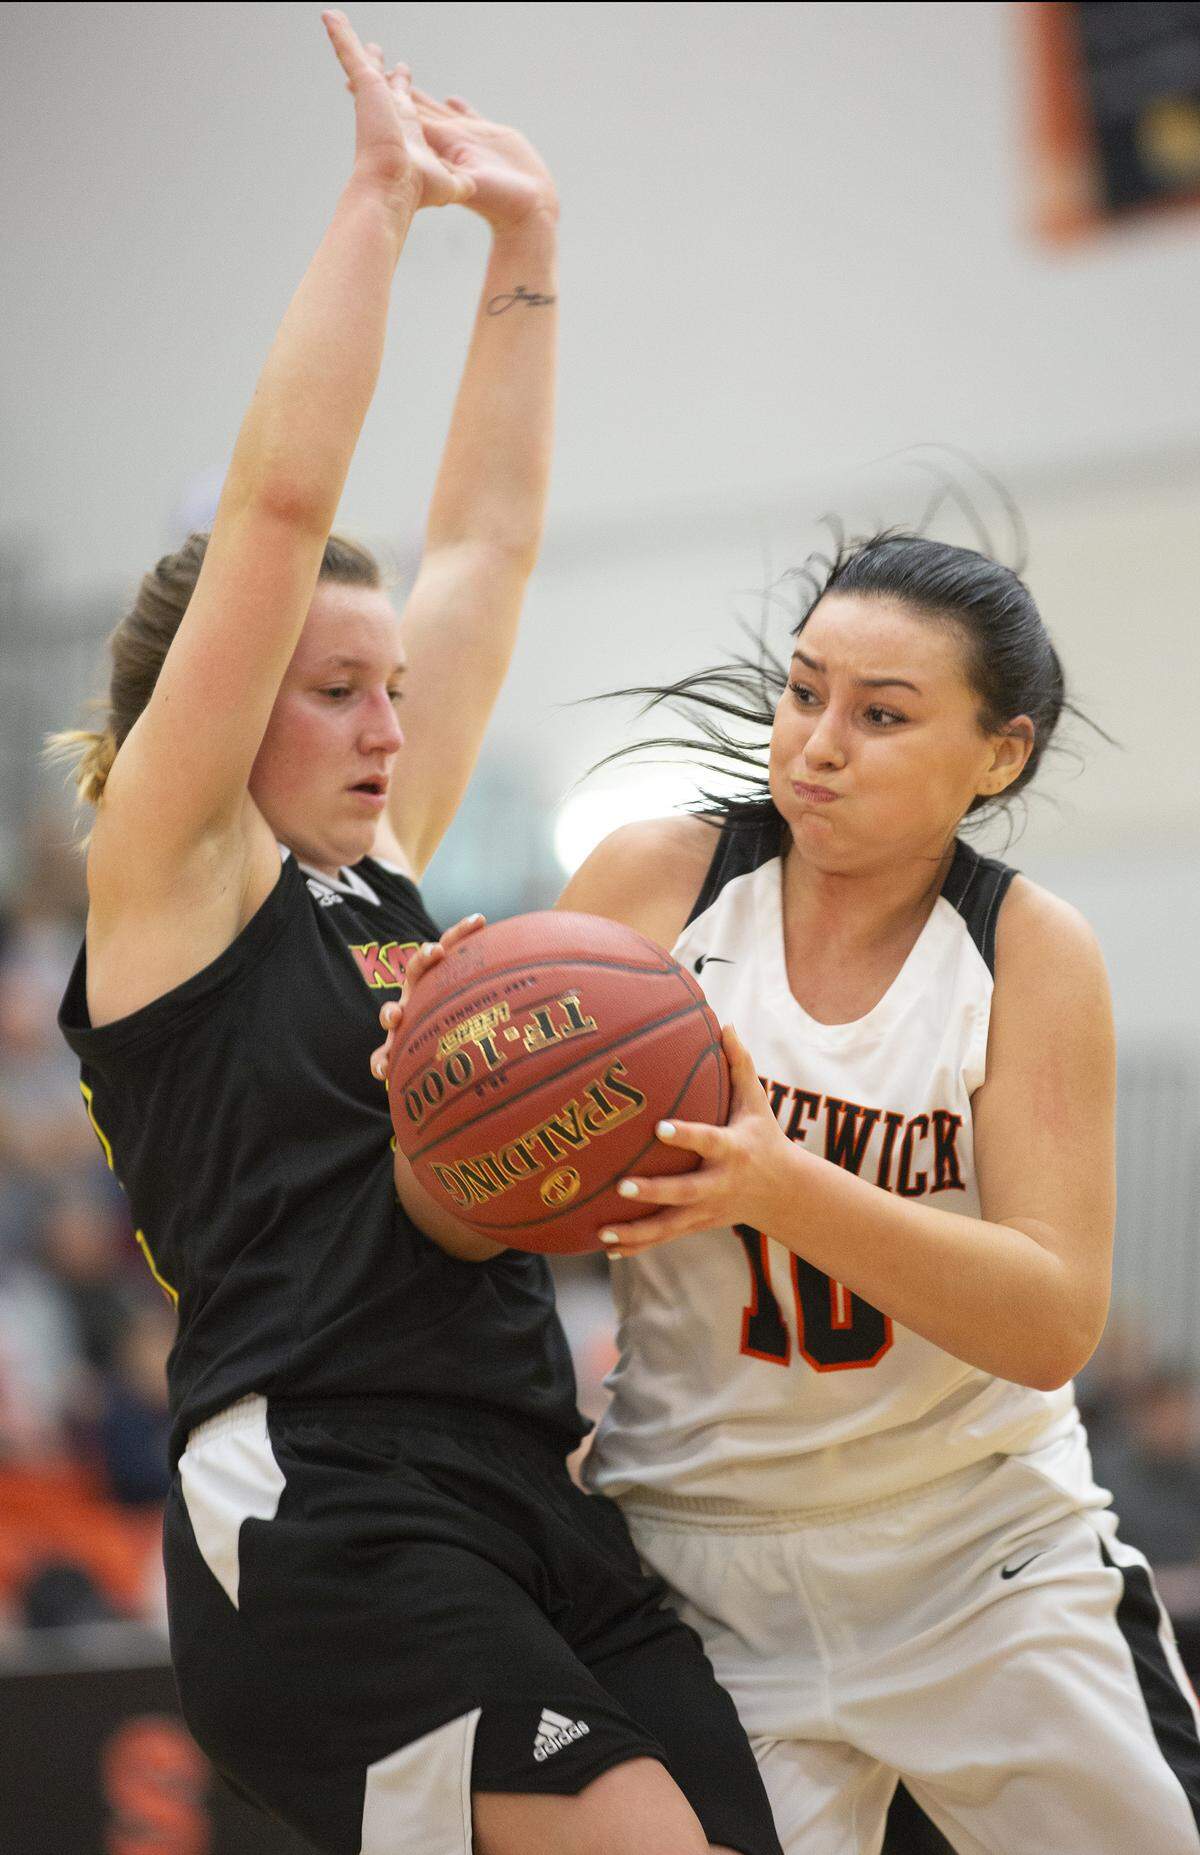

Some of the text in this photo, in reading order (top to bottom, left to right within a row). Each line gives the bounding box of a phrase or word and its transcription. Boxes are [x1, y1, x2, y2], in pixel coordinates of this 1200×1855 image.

[429, 1056, 648, 1211] SPALDING
[732, 1223, 894, 1374] 10
[533, 1720, 590, 1763] adidas
